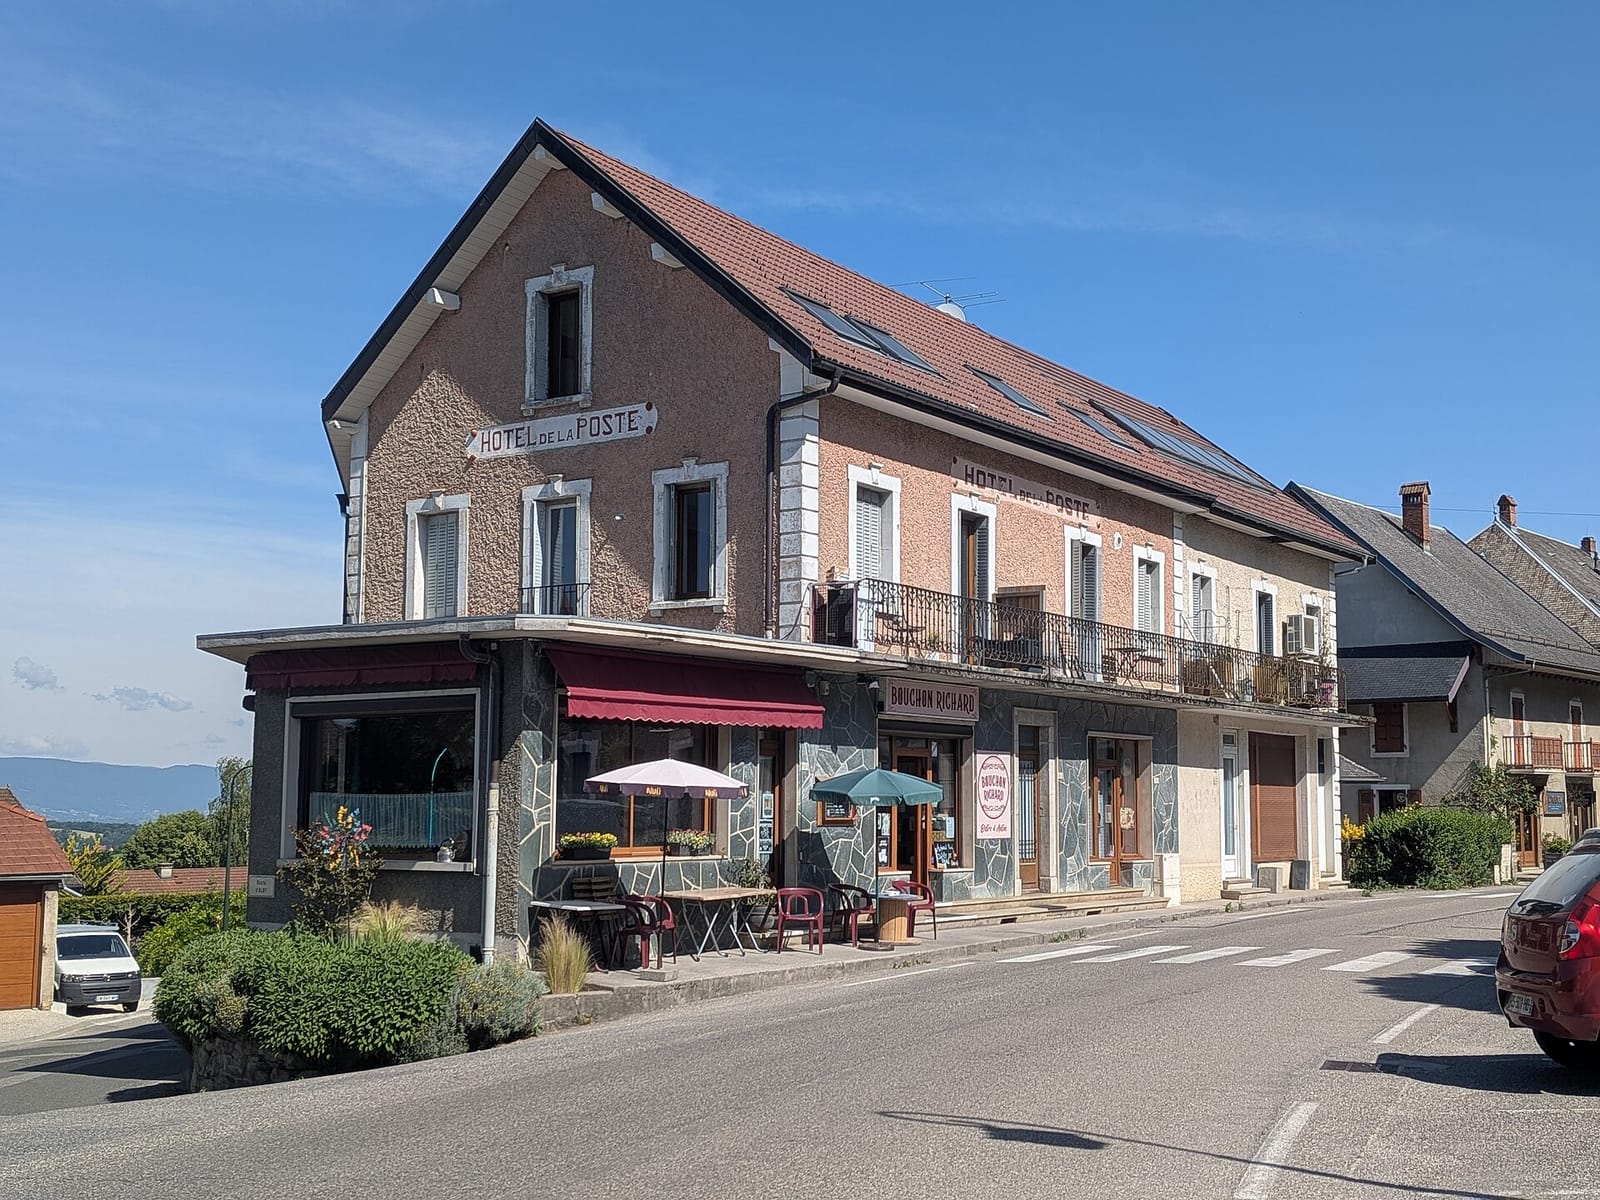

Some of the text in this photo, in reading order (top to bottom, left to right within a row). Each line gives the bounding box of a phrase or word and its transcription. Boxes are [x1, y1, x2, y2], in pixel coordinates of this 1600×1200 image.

[480, 409, 640, 453] HOTEL DE LA POSTE
[964, 464, 1017, 499] HOTEL
[1045, 489, 1090, 521] POSTE
[891, 686, 975, 714] BOUCHON RICHARD
[981, 775, 1006, 788] BOUCHON
[983, 789, 1004, 801] RICHARD
